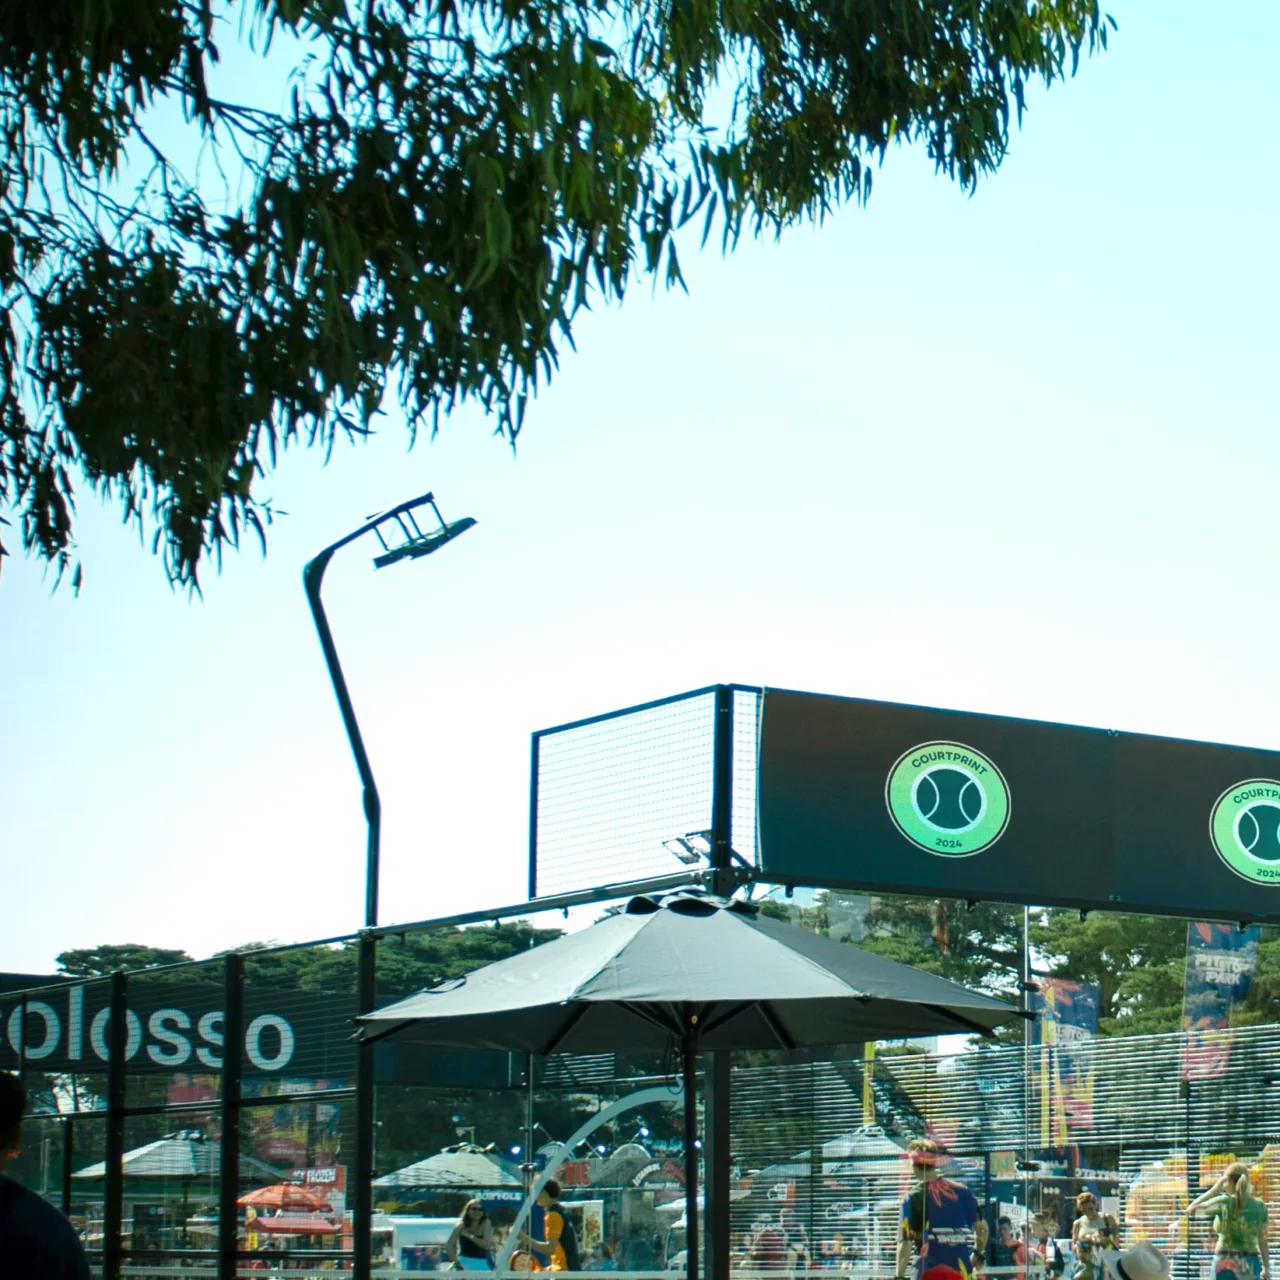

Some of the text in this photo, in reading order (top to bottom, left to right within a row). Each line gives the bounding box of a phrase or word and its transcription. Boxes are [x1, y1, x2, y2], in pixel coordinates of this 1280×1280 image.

[911, 751, 988, 775] COURTPRINT
[935, 838, 962, 848] 2024
[1256, 868, 1280, 878] 2024
[0, 985, 295, 1071] olosso
